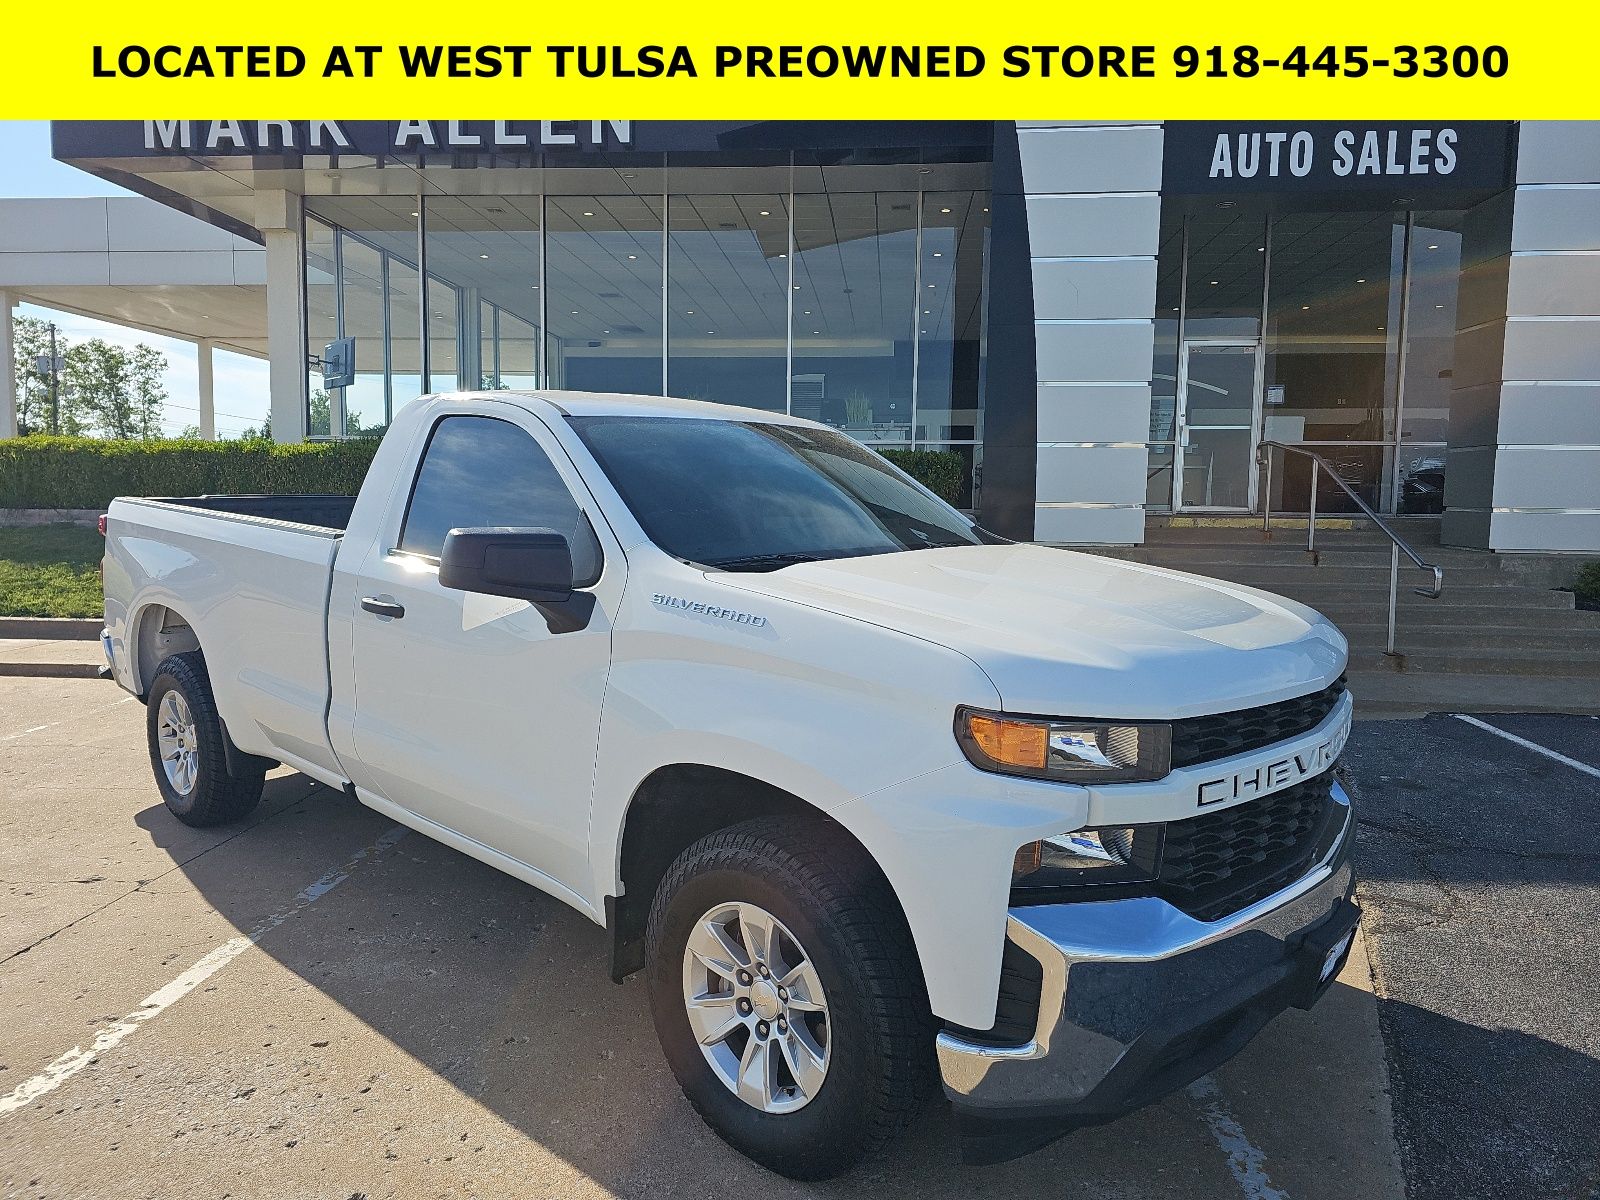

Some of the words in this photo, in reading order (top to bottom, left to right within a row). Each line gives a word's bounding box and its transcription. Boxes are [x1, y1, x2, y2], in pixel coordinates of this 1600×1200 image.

[1208, 130, 1314, 178] AUTO
[1332, 128, 1458, 177] SALES
[651, 592, 767, 628] SILVERADO
